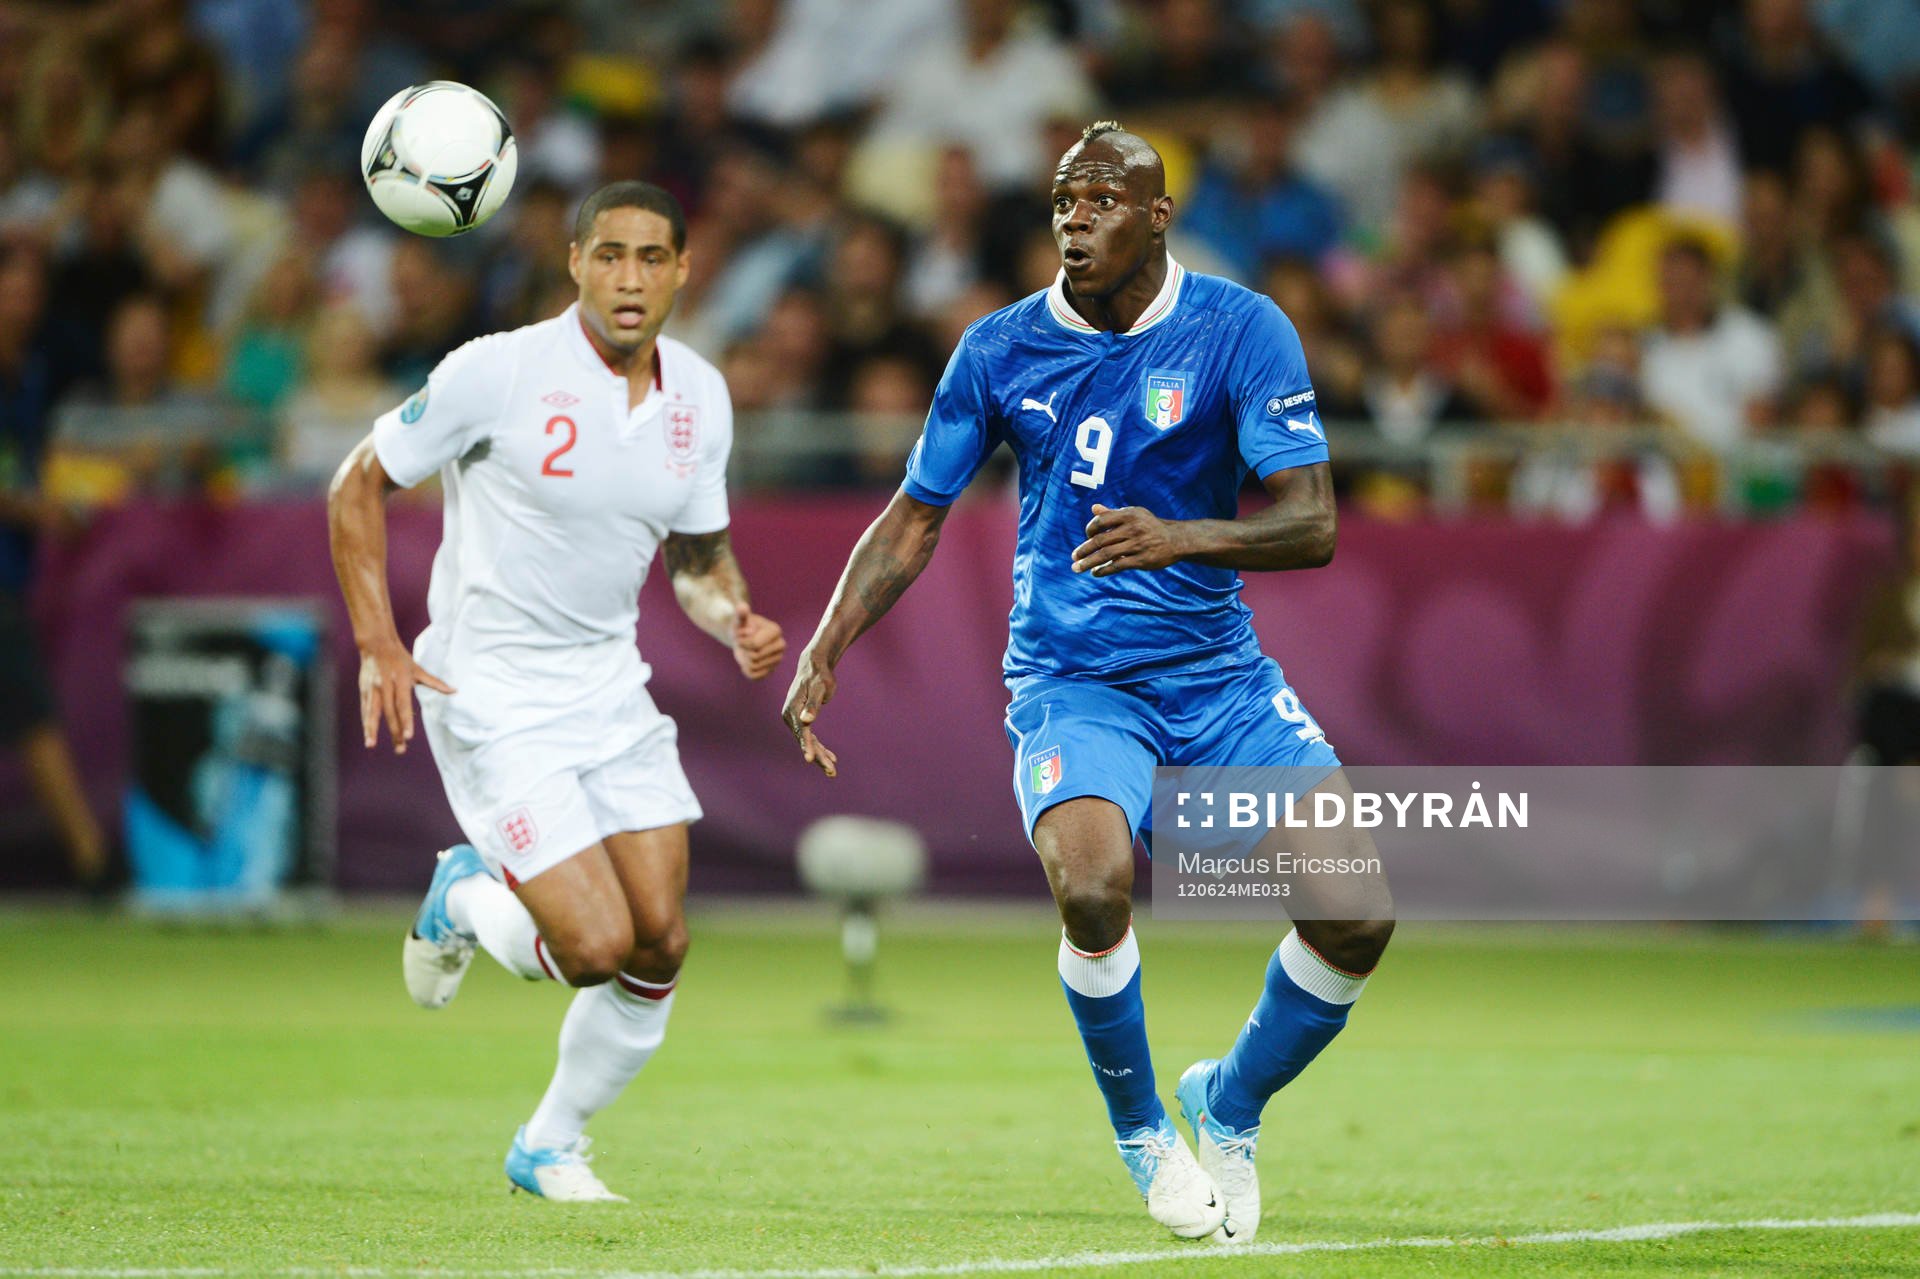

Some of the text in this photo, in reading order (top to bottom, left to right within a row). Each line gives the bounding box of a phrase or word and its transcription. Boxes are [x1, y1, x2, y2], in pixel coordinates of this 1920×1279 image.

[1153, 380, 1180, 389] ITALIA
[541, 415, 578, 478] 2
[1070, 416, 1113, 490] 9
[1271, 687, 1325, 741] 9
